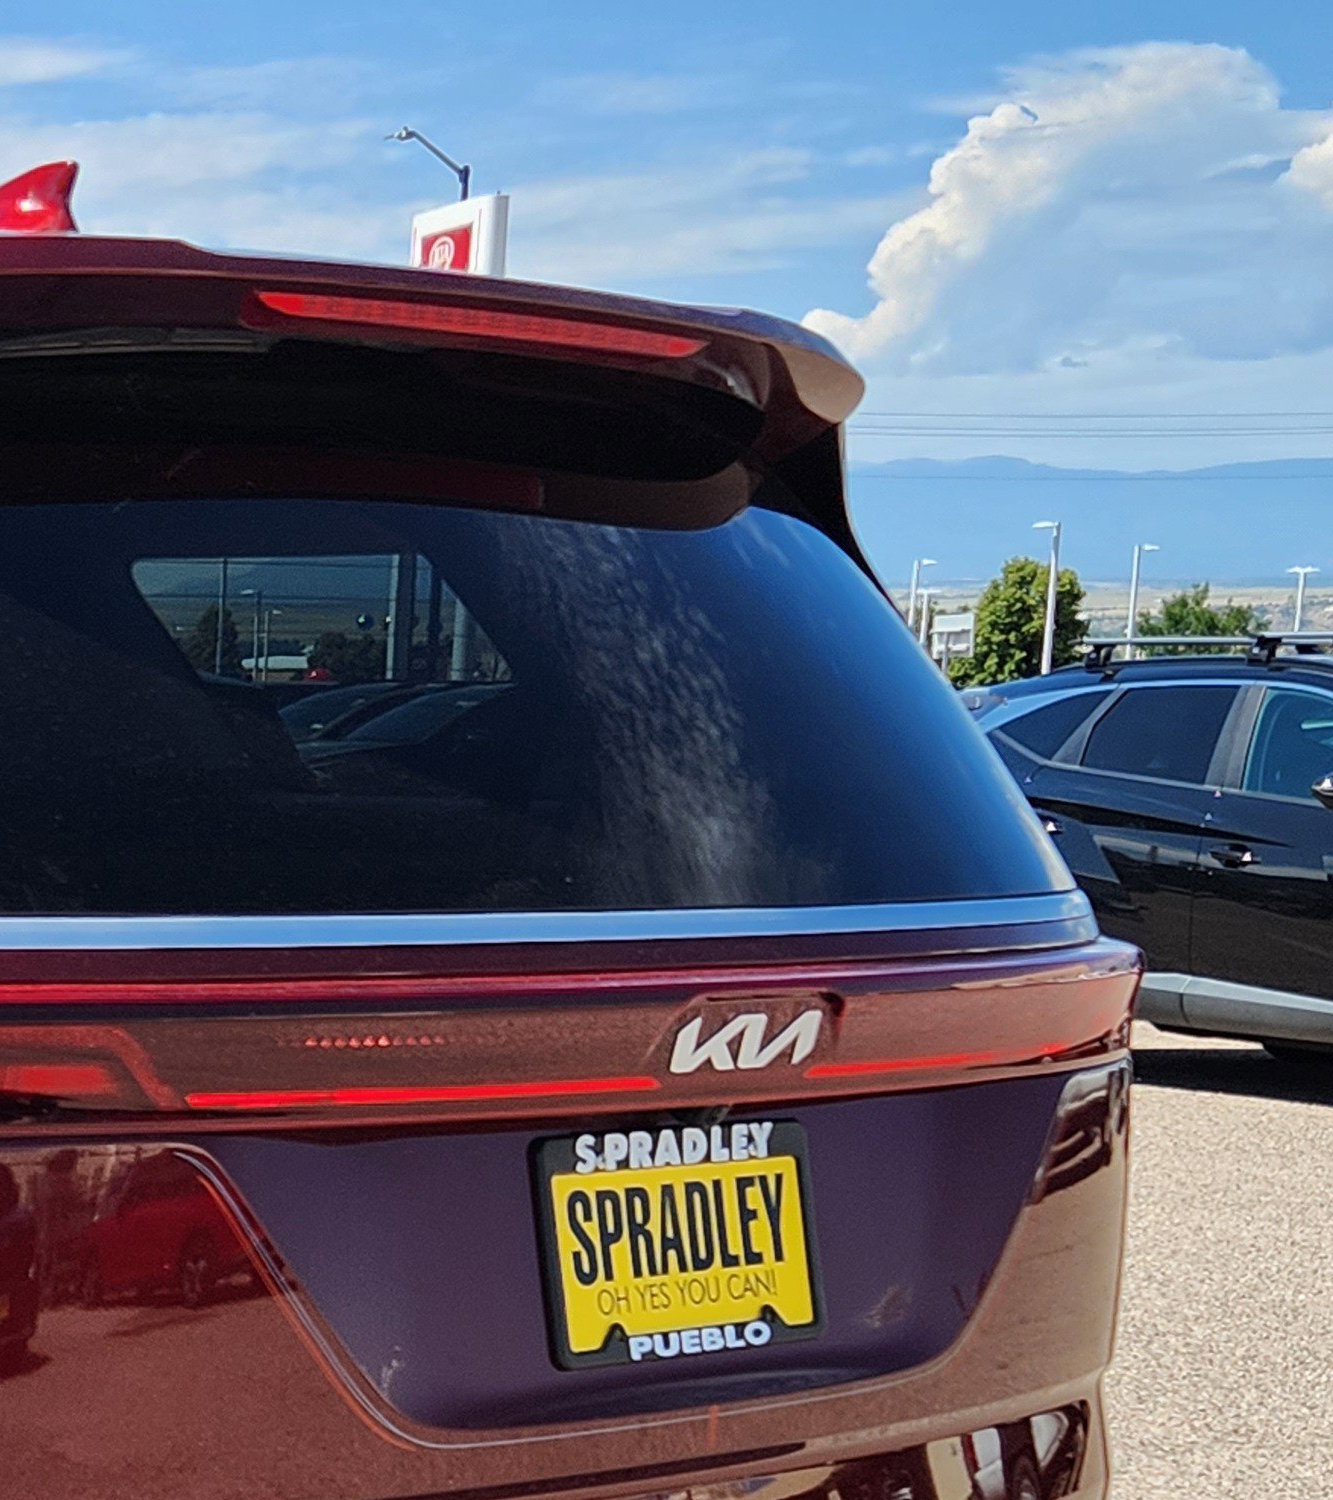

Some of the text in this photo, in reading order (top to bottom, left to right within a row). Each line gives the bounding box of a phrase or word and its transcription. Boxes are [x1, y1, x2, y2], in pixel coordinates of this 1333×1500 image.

[575, 1121, 774, 1173] SPRADLEY
[567, 1172, 785, 1286] SPRADLEY
[597, 1268, 779, 1316] OH YES YOU CAN!
[628, 1320, 773, 1362] PUEBLO
